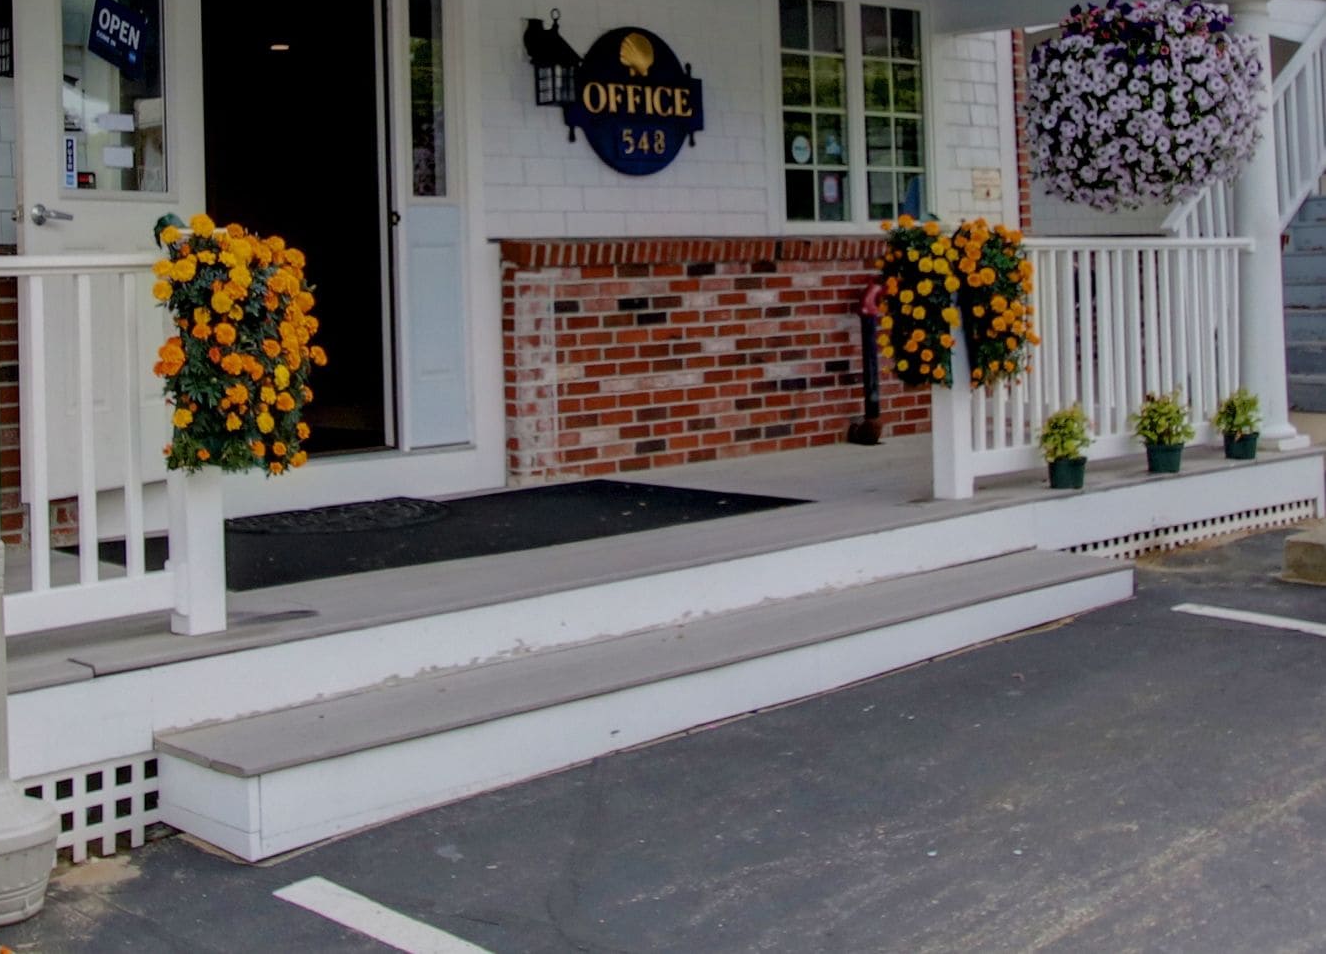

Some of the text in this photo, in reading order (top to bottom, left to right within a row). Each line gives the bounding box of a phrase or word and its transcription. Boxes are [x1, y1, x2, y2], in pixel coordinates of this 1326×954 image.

[98, 8, 140, 50] OPEN
[583, 82, 693, 117] OFFICE
[622, 129, 665, 155] 548
